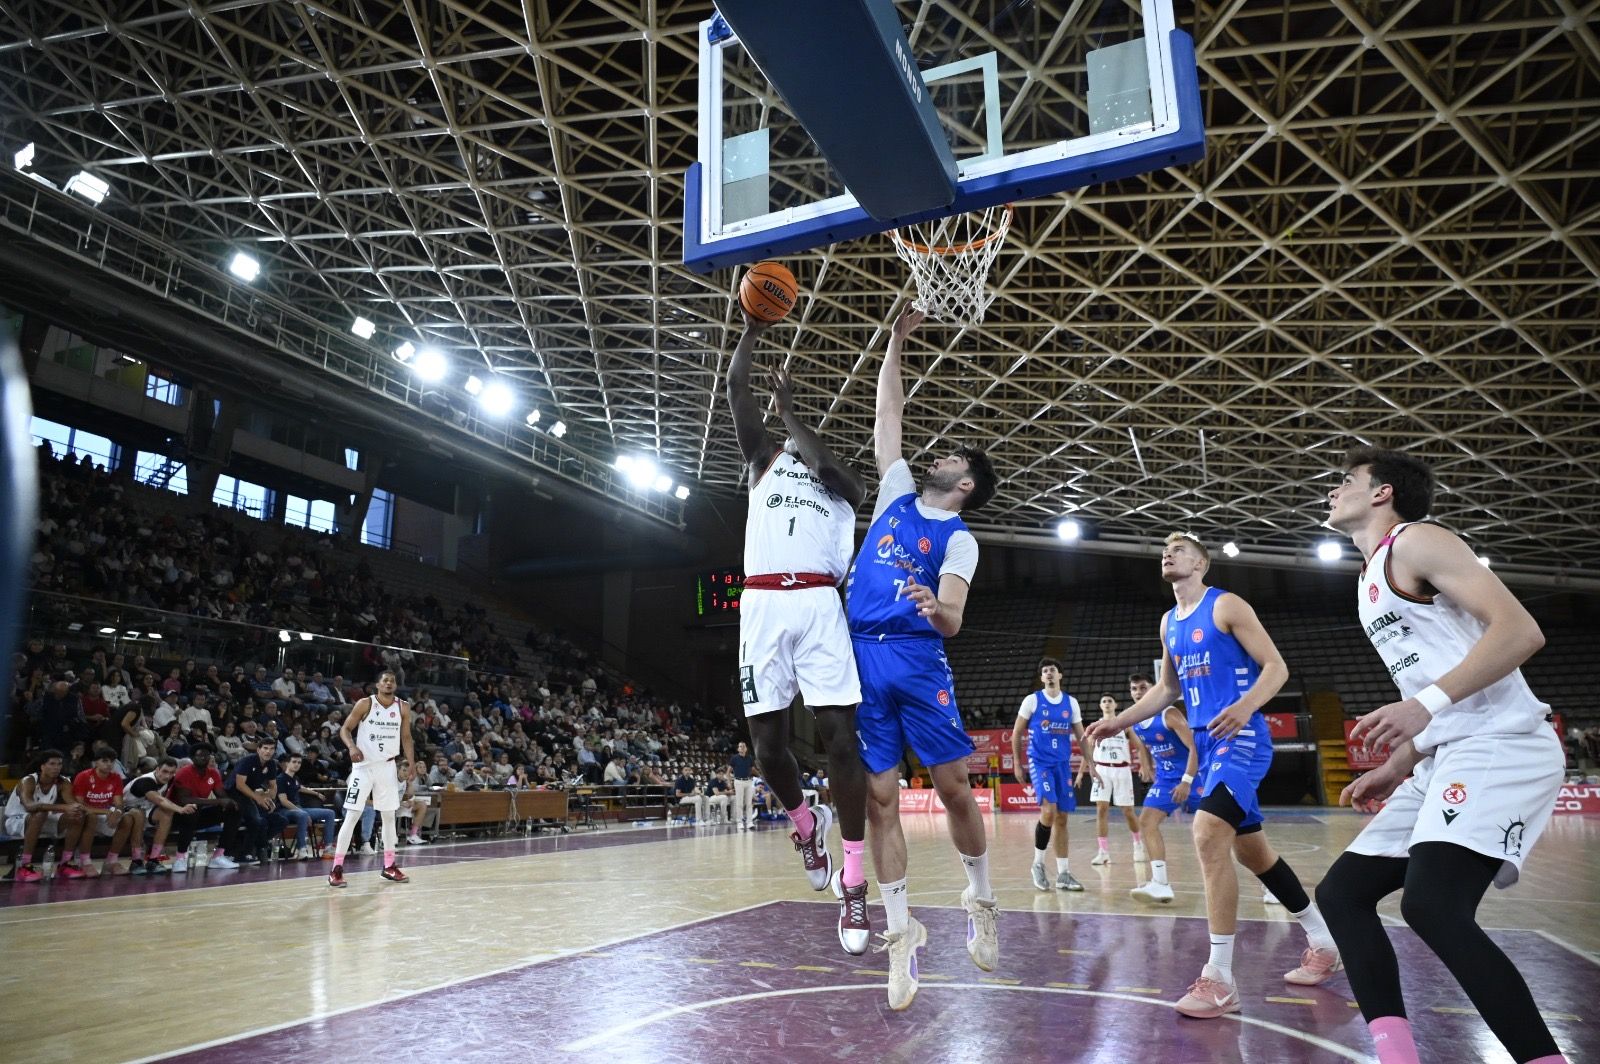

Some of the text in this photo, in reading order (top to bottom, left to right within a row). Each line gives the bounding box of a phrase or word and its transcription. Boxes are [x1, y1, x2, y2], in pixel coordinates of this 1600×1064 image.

[895, 38, 922, 104] MONDO
[763, 280, 793, 307] Wilson
[784, 495, 830, 518] E.Leclerc
[788, 516, 796, 537] 1
[893, 578, 906, 602] 7
[378, 743, 384, 752] 5
[1051, 739, 1058, 748] 6
[1109, 751, 1118, 760] 10
[352, 778, 360, 787] 5
[1043, 782, 1051, 791] 6
